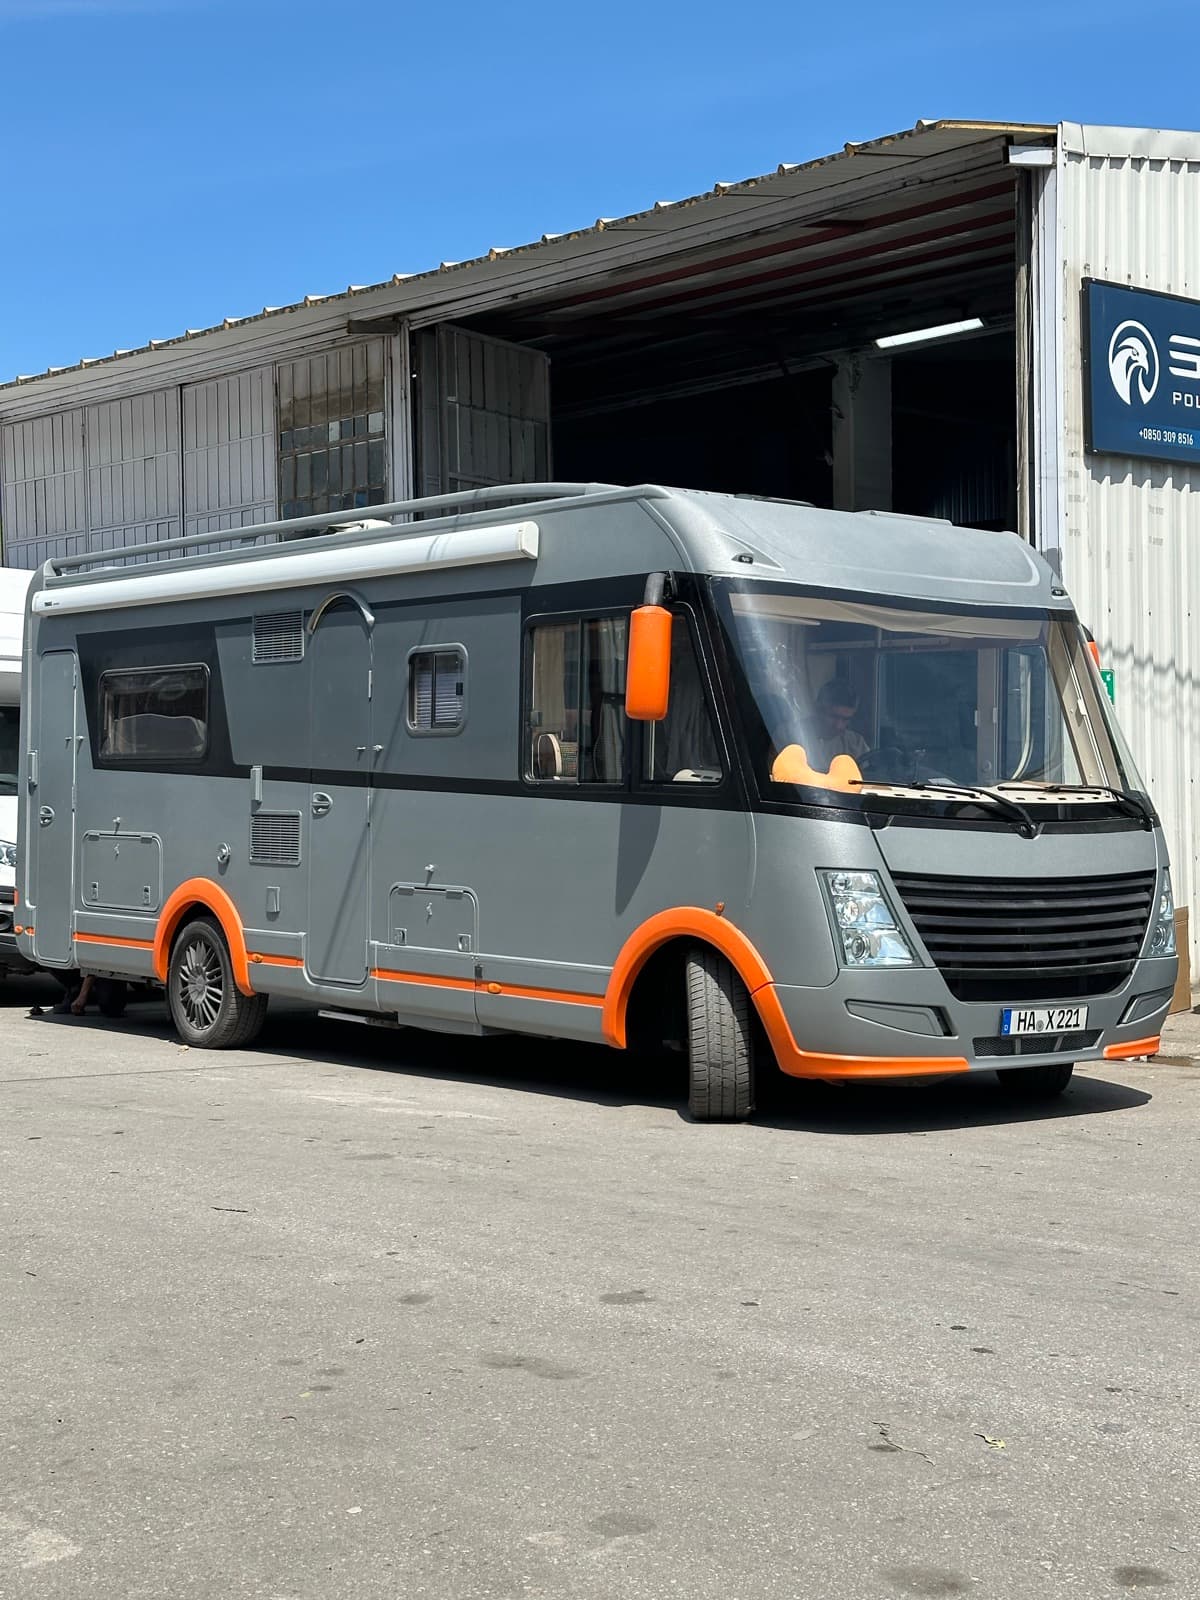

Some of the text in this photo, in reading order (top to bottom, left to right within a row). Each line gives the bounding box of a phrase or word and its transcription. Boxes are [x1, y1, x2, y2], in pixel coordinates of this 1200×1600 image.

[1139, 427, 1194, 445] +0850 309 8516
[1017, 1011, 1036, 1032] HA
